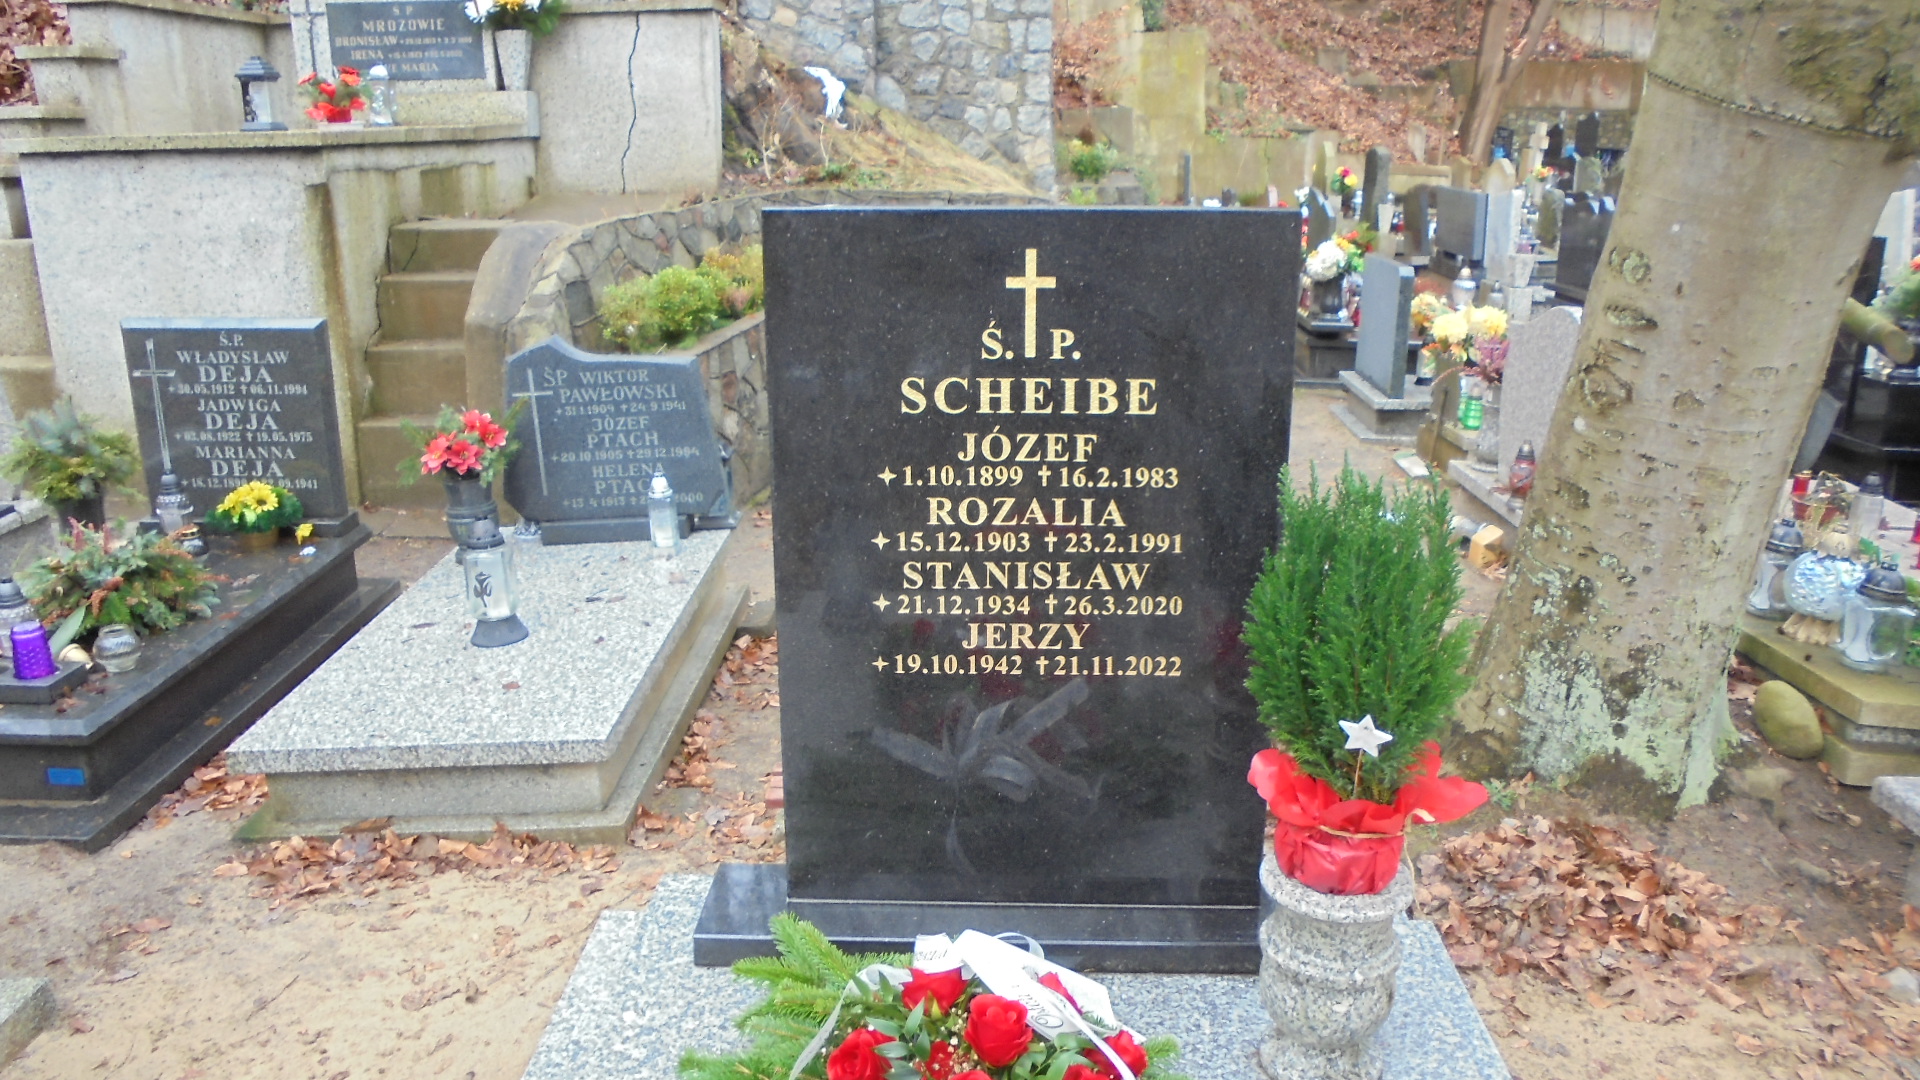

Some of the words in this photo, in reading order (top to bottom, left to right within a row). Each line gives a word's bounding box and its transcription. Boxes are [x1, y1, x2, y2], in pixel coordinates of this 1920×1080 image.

[351, 49, 384, 60] IRENA
[402, 63, 438, 72] MARIA
[176, 350, 290, 364] WŁADYSŁAW
[199, 365, 273, 383] DEJA
[579, 369, 649, 384] WIKTOR
[559, 384, 677, 403] PAWŁOWSKI
[900, 377, 1158, 415] SCHEIBE
[197, 399, 281, 412] JADWIGA
[204, 413, 278, 430] DEJA
[587, 431, 659, 449] PTACH
[957, 425, 1098, 463] JÓZEF
[195, 446, 296, 459] MARIANNA
[211, 460, 284, 477] DEJA
[592, 461, 664, 478] HELENA
[902, 465, 1024, 486] 1.10.1899
[1058, 467, 1179, 488] 16.2.1983
[595, 477, 650, 495] PTAC
[926, 496, 1126, 527] ROZALIA
[896, 531, 1031, 552] 15.12.1903
[1065, 533, 1183, 553] 23.2.1991
[902, 560, 1150, 590] STANISŁAW
[897, 595, 1031, 615] 21.12.1934
[1064, 595, 1183, 615] 26.3.2020
[961, 622, 1090, 650] JERZY
[894, 654, 1023, 675] 19.10.1942
[1053, 656, 1182, 676] 21.11.2022
